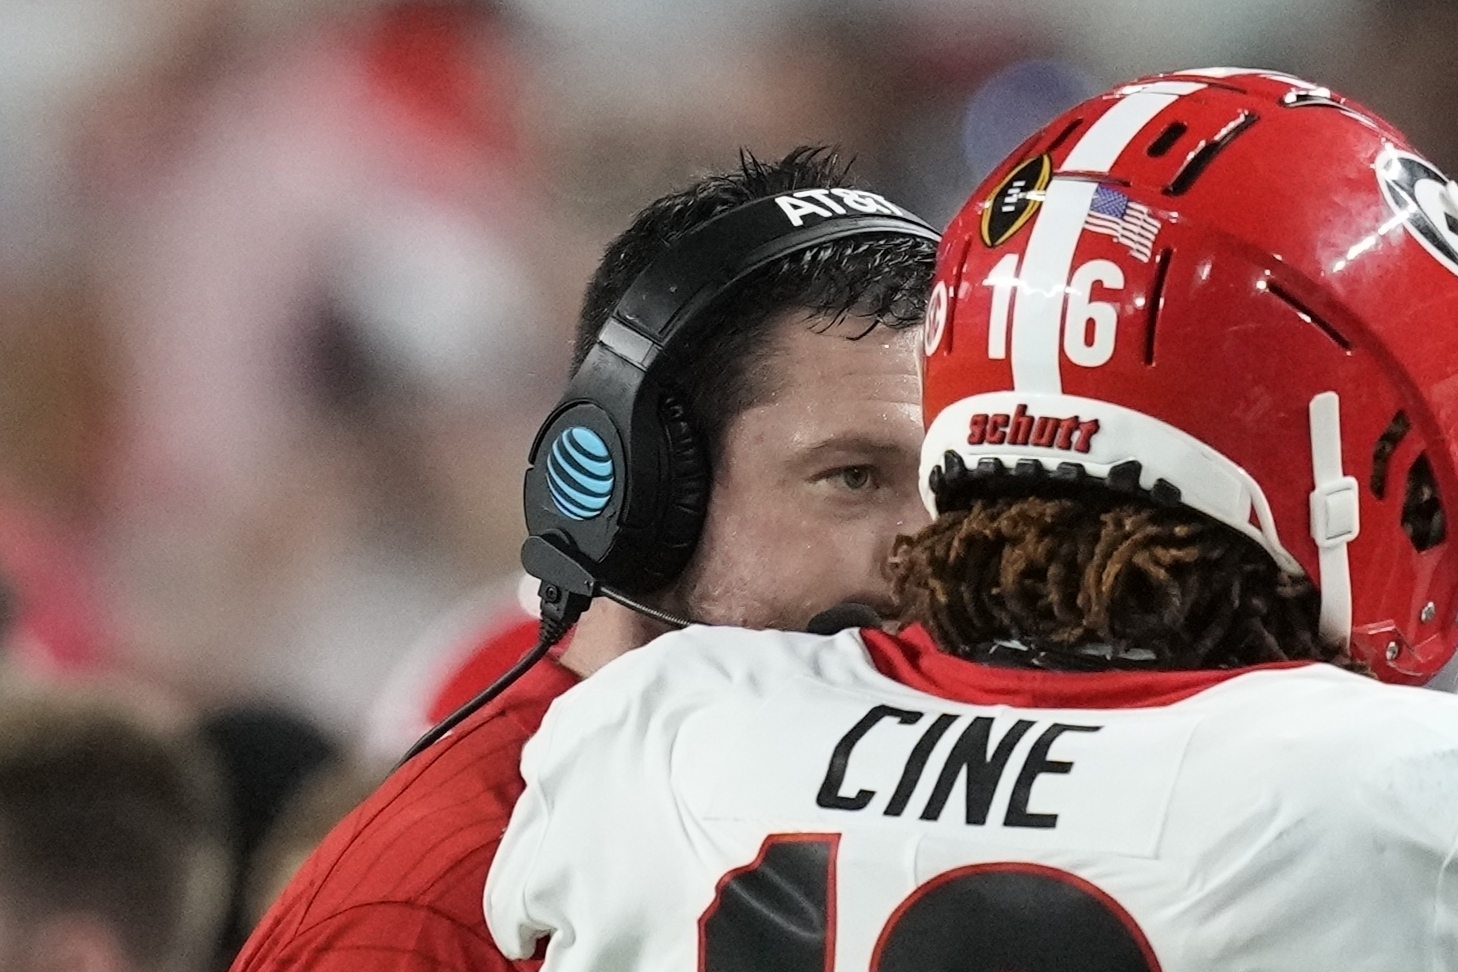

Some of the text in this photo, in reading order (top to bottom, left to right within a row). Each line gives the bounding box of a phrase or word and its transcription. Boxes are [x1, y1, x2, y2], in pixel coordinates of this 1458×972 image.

[774, 187, 904, 227] AT&T
[983, 252, 1126, 368] 16
[967, 403, 1100, 454] schutt
[815, 704, 1105, 829] CINE
